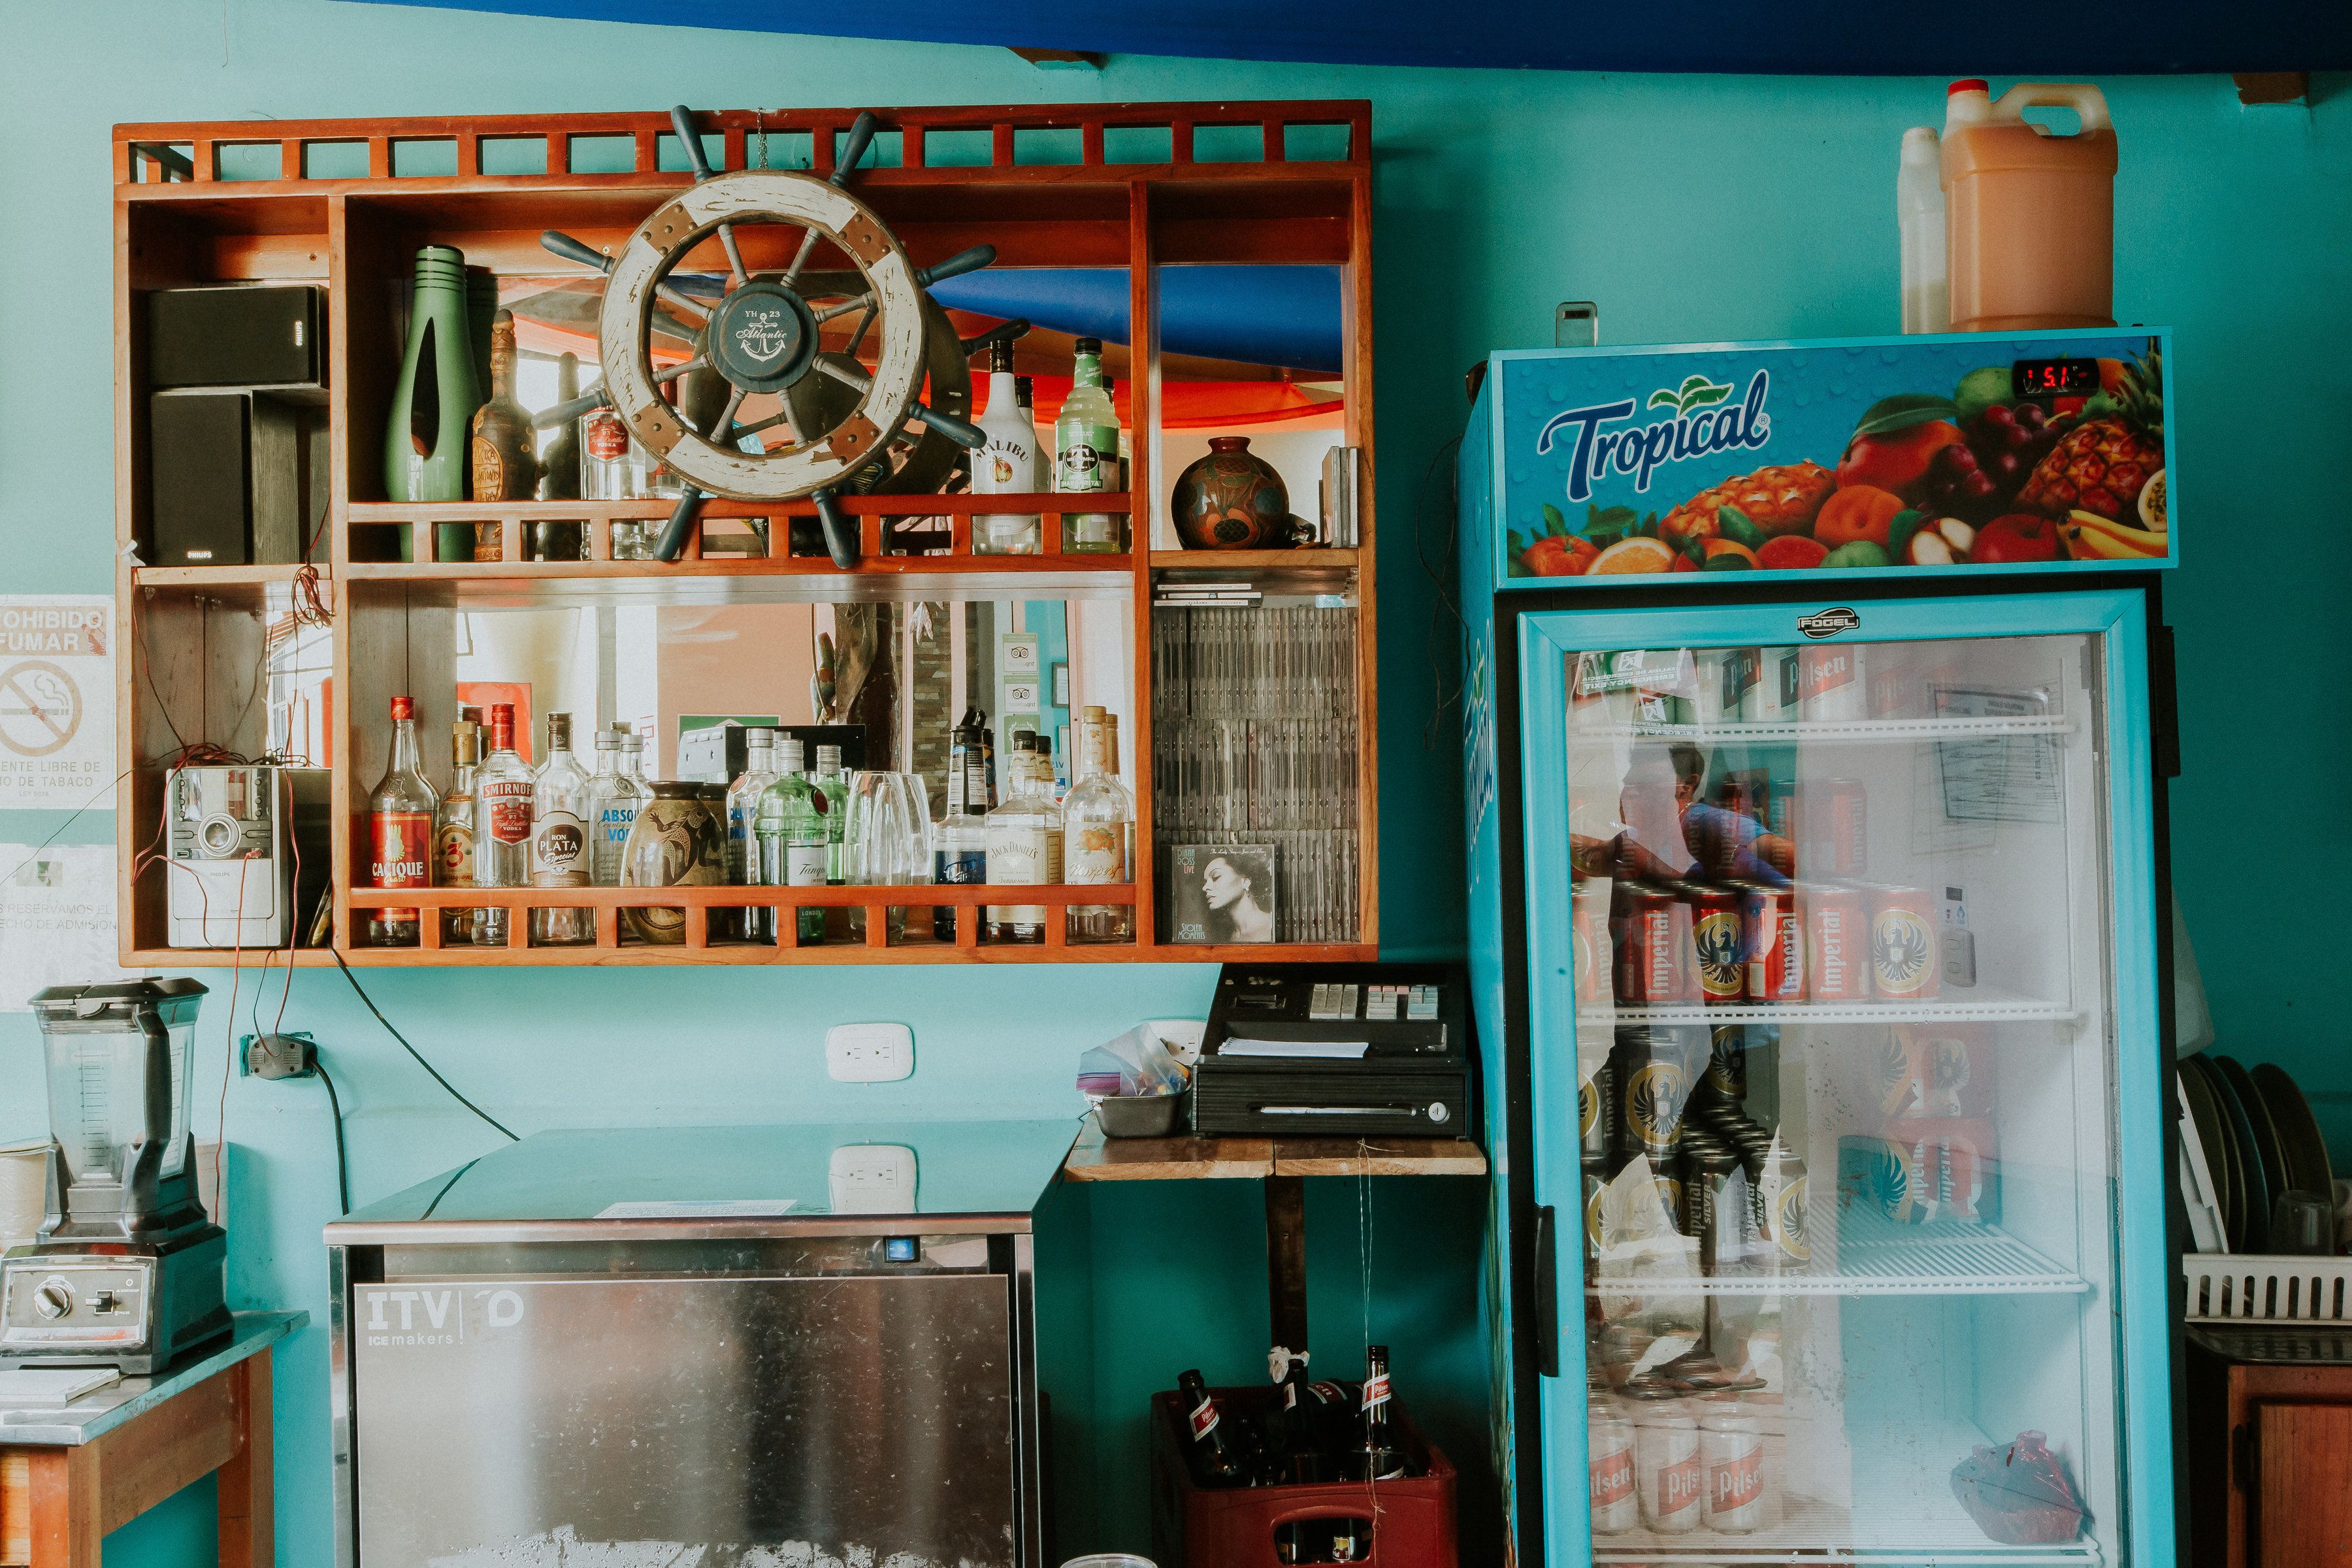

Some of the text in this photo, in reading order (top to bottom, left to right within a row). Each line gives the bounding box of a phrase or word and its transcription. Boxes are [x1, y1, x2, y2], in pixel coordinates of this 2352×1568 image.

[736, 326, 787, 339] Atlantic
[1537, 369, 1771, 502] Tropical
[976, 440, 1029, 463] MALIBU
[1801, 619, 1855, 628] FOGEL
[41, 762, 77, 772] LIBRE
[84, 762, 100, 772] DE
[19, 777, 34, 787] DE
[42, 776, 93, 787] TABACO
[540, 840, 578, 851] PLATA
[992, 841, 1039, 860] JACK DANIEL'S
[446, 841, 464, 868] 3
[1177, 849, 1195, 857] DIANA
[372, 862, 423, 877] CACIQUE
[1184, 865, 1195, 874] LIVE
[384, 875, 406, 887] Guaro
[8, 904, 93, 915] RESERVAMOS
[96, 904, 112, 915] EL
[37, 919, 53, 929] DE
[56, 919, 117, 930] ADMISION
[1181, 923, 1202, 933] STOLEN
[1178, 931, 1206, 939] MOMENTS
[1648, 912, 1673, 996] Imperial
[1777, 911, 1797, 995] Imperial
[1818, 911, 1847, 994] Imperial
[1603, 1068, 1614, 1139] Imperial
[1704, 1184, 1712, 1225] SILVER
[367, 1290, 452, 1330] ITV
[368, 1332, 453, 1346] ICE makers
[1375, 1384, 1388, 1394] Pilsen
[1720, 1468, 1761, 1503] Pilse
